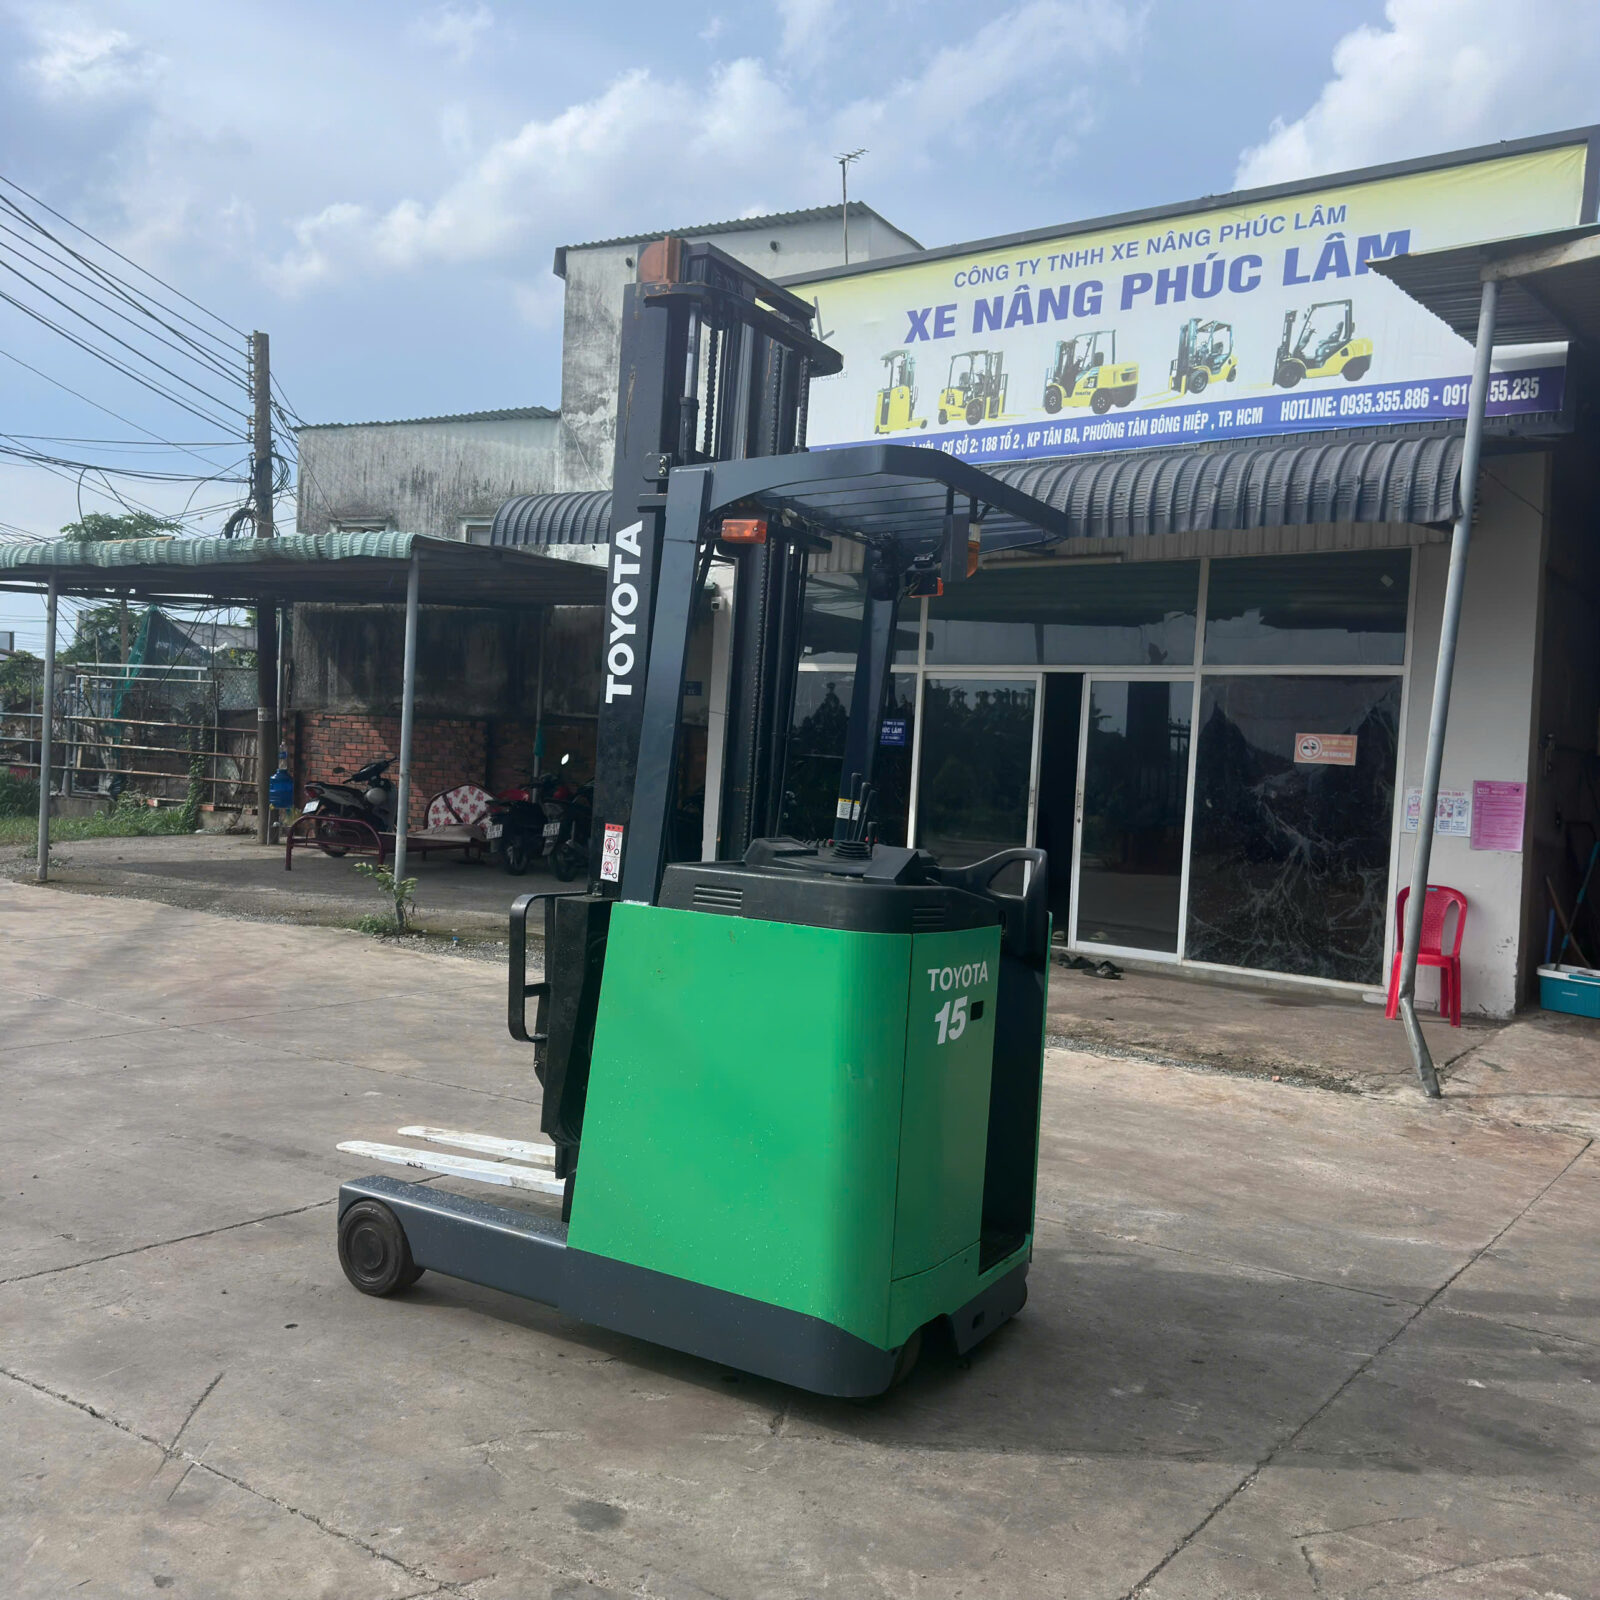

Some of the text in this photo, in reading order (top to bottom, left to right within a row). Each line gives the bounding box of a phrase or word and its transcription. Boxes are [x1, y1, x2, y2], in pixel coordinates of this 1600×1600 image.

[954, 204, 1347, 288] CÔNG TY TNHH XE NÂNG PHÚC LÂM
[904, 229, 1411, 344] XE NÂNG PHÚC LÂM
[1280, 396, 1336, 422] HOTLINE:
[1339, 387, 1430, 416] 0935.355.886
[955, 434, 970, 455] SỞ
[970, 438, 979, 454] 2:
[981, 436, 997, 453] 188
[1000, 428, 1013, 450] TỔ
[1012, 434, 1020, 449] 2
[1027, 431, 1041, 448] KP
[1043, 426, 1063, 446] TÂN
[1064, 427, 1080, 444] BA,
[1082, 419, 1125, 442] PHƯỜNG
[1127, 416, 1148, 438] TÂN
[1150, 412, 1180, 435] ĐÔNG
[1182, 409, 1209, 434] HIỆP
[1218, 410, 1233, 428] TP.
[1236, 406, 1264, 425] HCM
[605, 520, 643, 704] TOYOTA
[927, 961, 988, 992] TOYOTA
[934, 996, 968, 1045] 15
